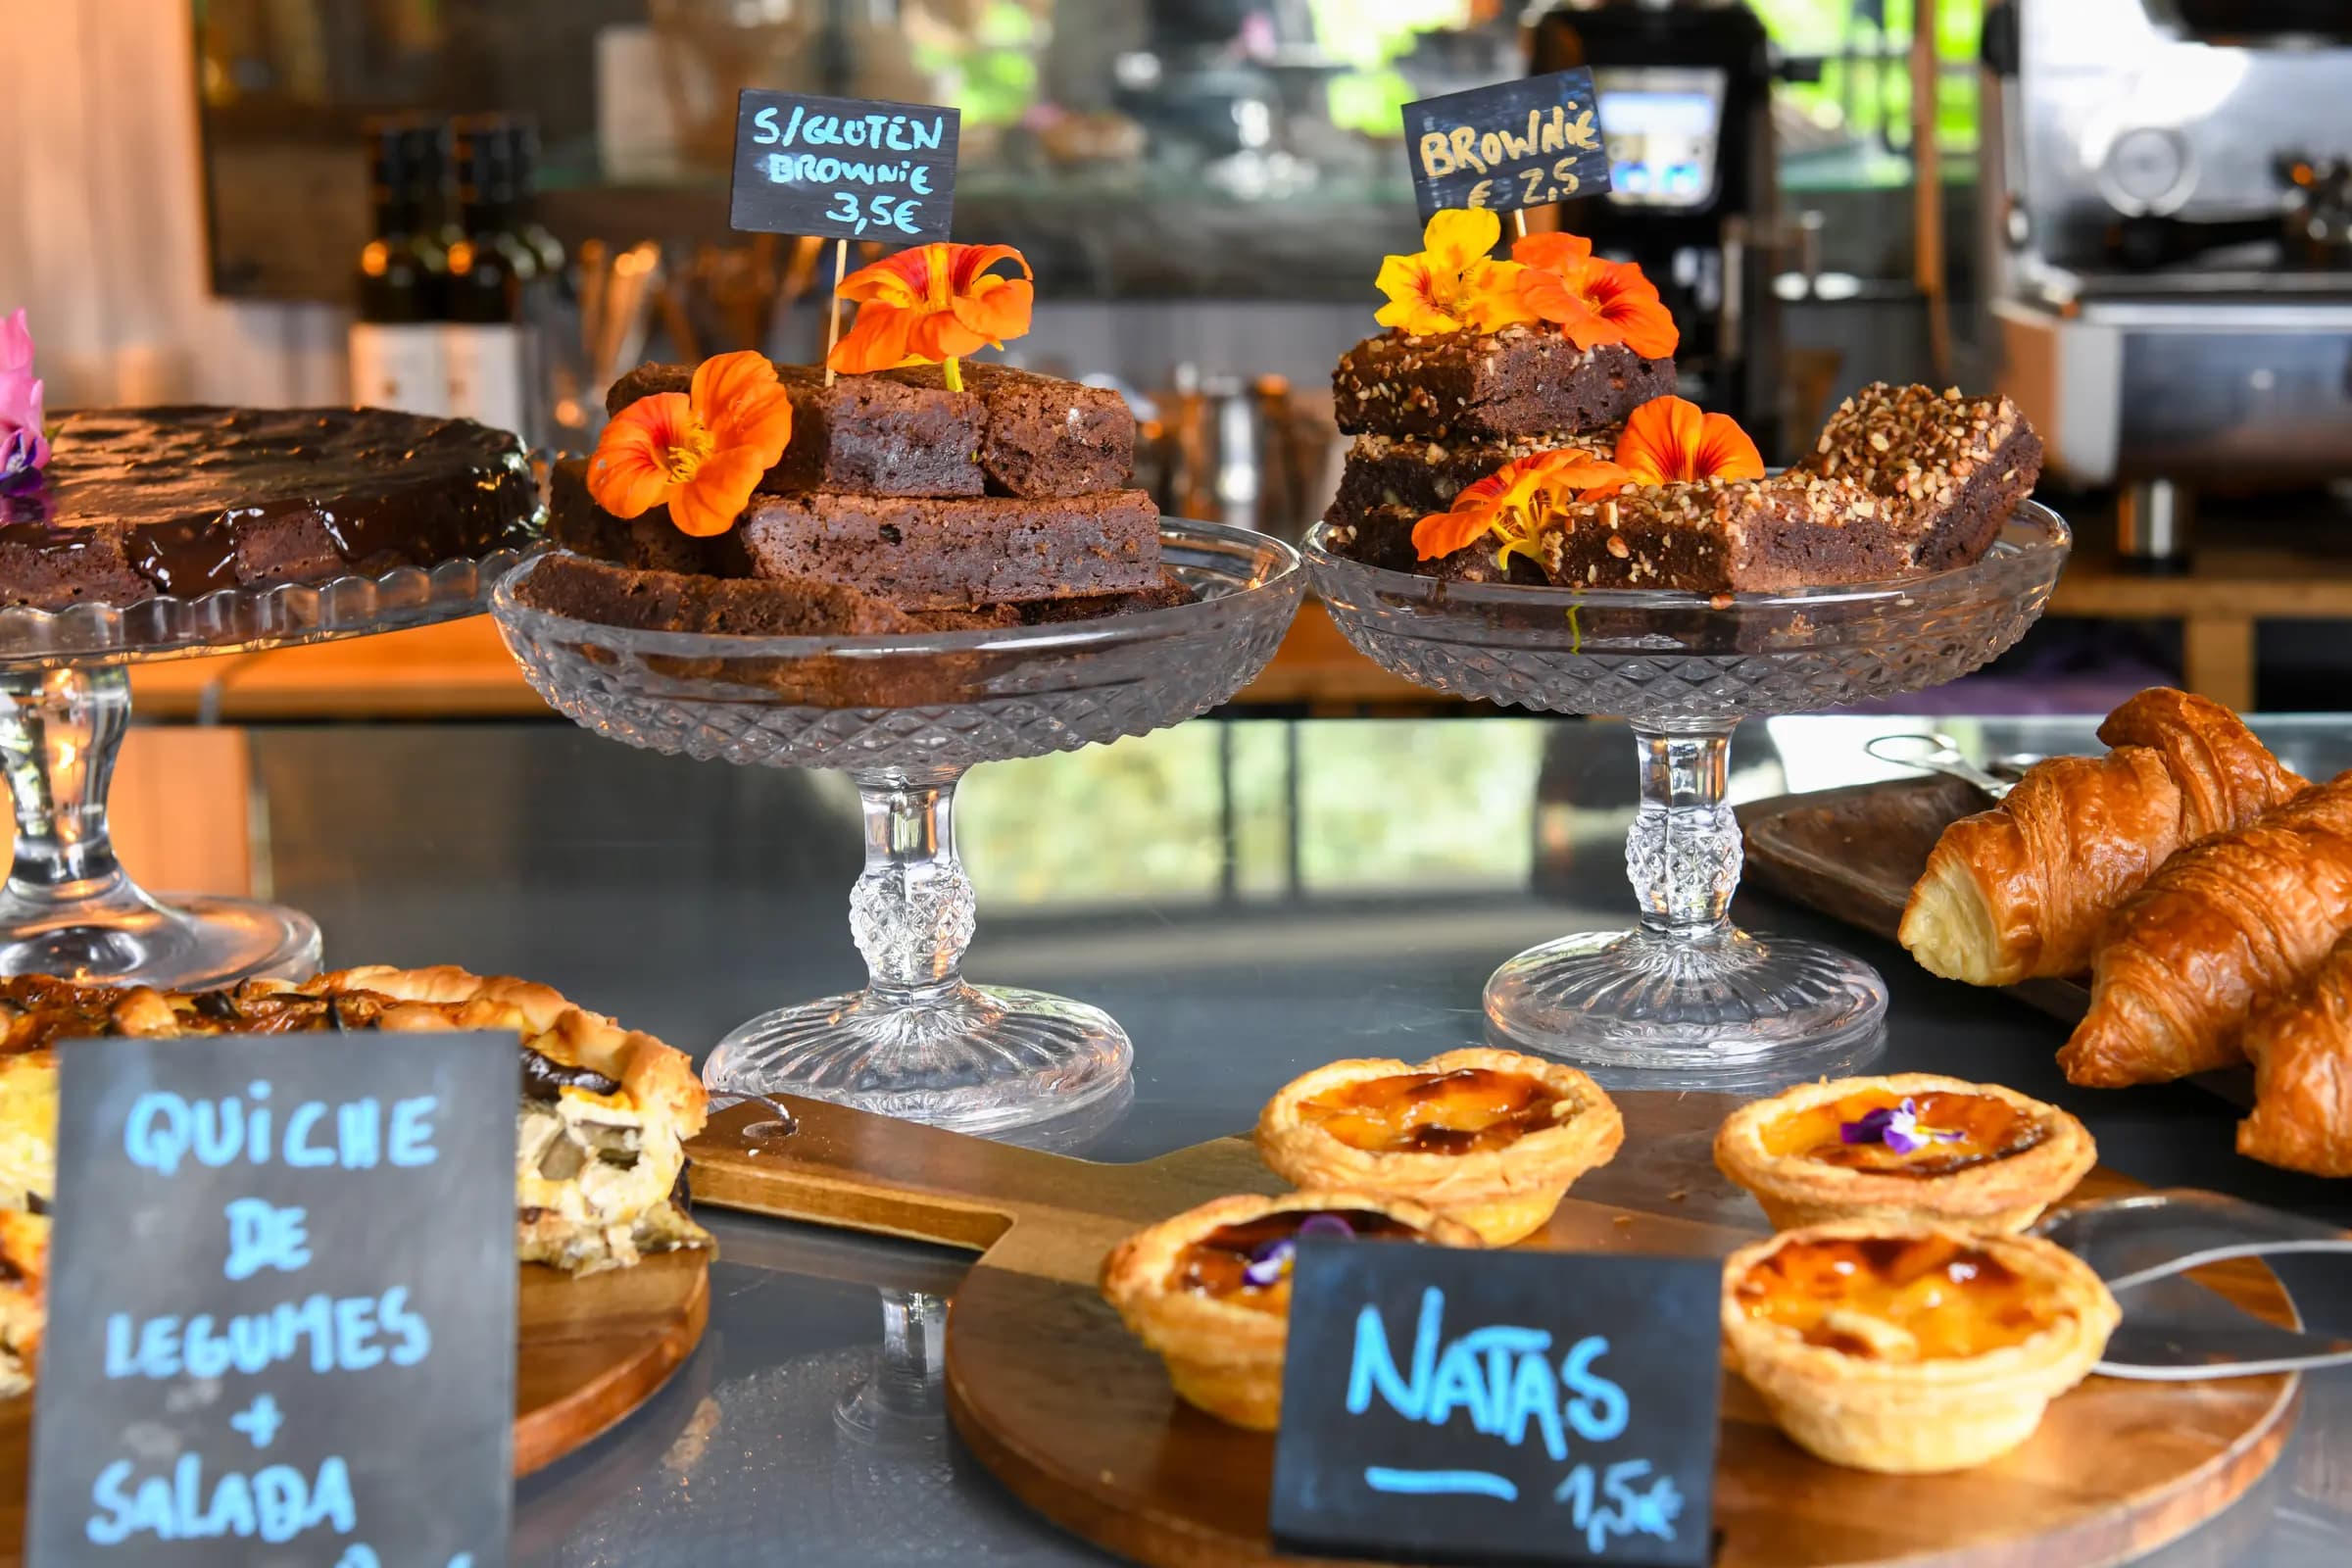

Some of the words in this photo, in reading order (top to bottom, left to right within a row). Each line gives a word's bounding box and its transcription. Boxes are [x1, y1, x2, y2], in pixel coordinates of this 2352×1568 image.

[825, 192, 923, 235] 3,5€
[223, 1198, 312, 1281] DE
[105, 1287, 430, 1380] LEGUMES
[1346, 1286, 1630, 1460] NATAS
[85, 1452, 357, 1545] SALADA
